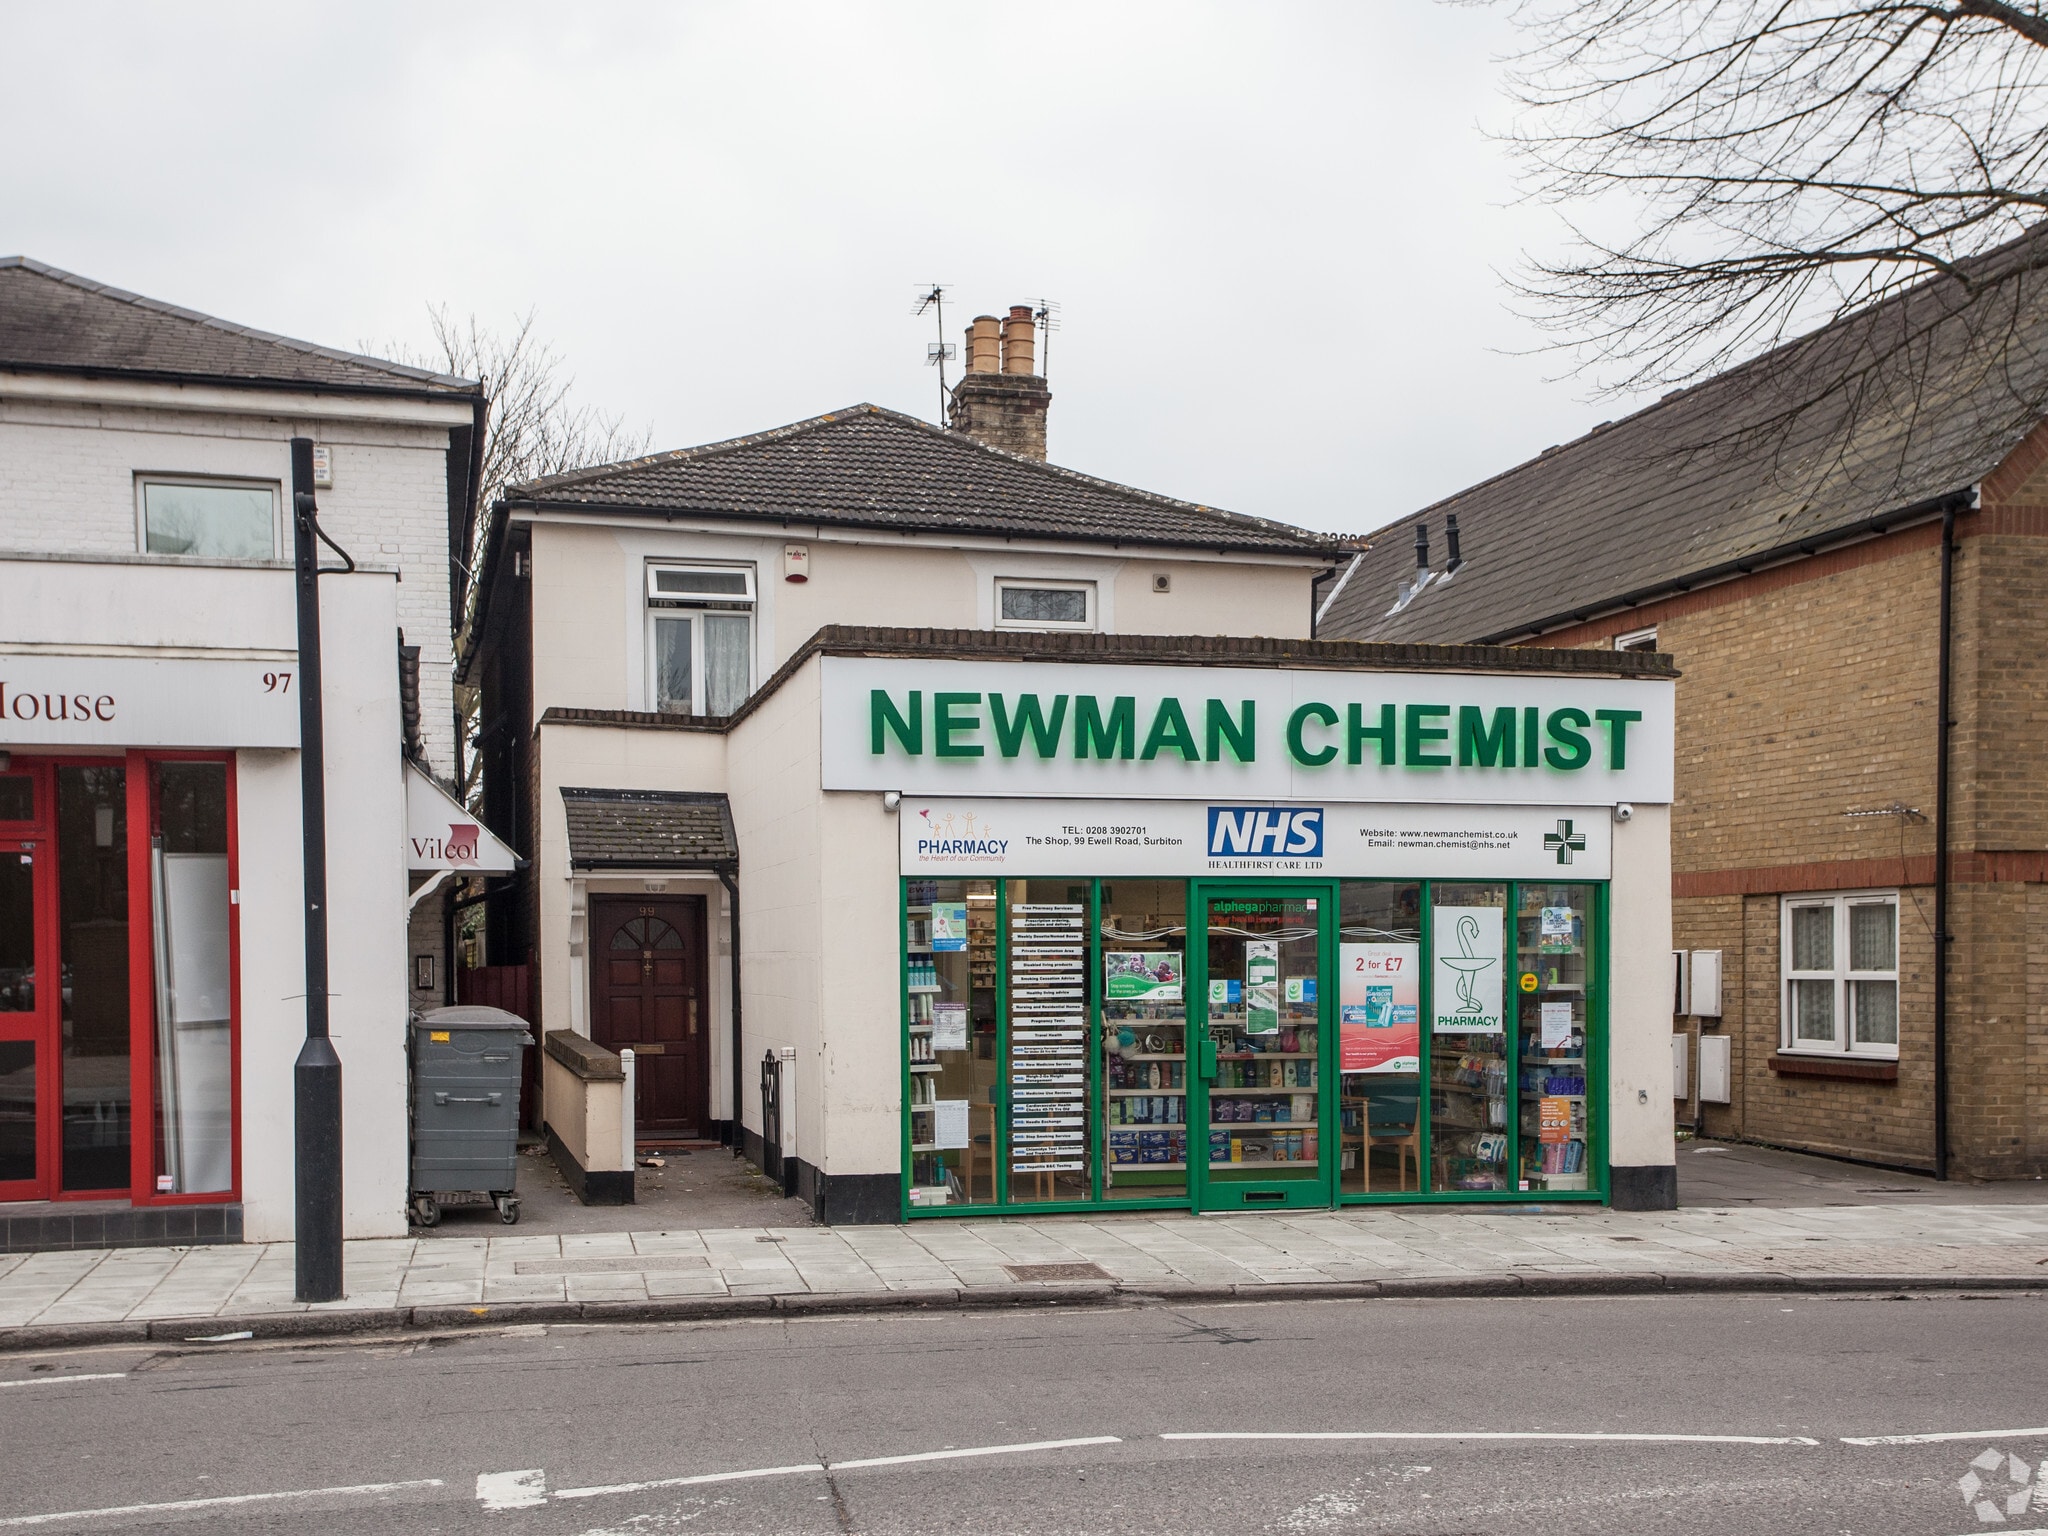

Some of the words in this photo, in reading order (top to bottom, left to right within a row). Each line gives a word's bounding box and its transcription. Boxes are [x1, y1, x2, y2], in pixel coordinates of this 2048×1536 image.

[262, 672, 292, 694] 97
[870, 689, 1255, 763] NEWMAN
[1286, 702, 1642, 771] CHEMIST
[1062, 826, 1083, 834] TEL:
[1086, 827, 1107, 835] 0208
[1110, 827, 1146, 835] 3902701
[1211, 811, 1320, 853] NHS
[1360, 829, 1398, 837] Website:
[1400, 830, 1518, 838] www.newmanchemist.co.uk
[1026, 836, 1042, 845] The
[1045, 837, 1071, 846] Shop,
[1115, 837, 1141, 846] Road,
[1144, 837, 1182, 845] Surbiton
[1368, 839, 1395, 847] Email:
[1398, 840, 1510, 850] newman.chemist@nhs.net
[411, 838, 478, 859] Vilcol
[918, 840, 1008, 854] PHARMACY
[970, 855, 1005, 863] Community
[1208, 861, 1273, 869] HEALTHFIRST
[1276, 861, 1301, 869] CARE
[1305, 861, 1322, 869] LTD
[640, 906, 655, 916] 99
[1356, 958, 1364, 971] 2
[1368, 960, 1381, 968] for
[1385, 958, 1402, 971] £7
[1438, 1016, 1498, 1026] PHARMACY
